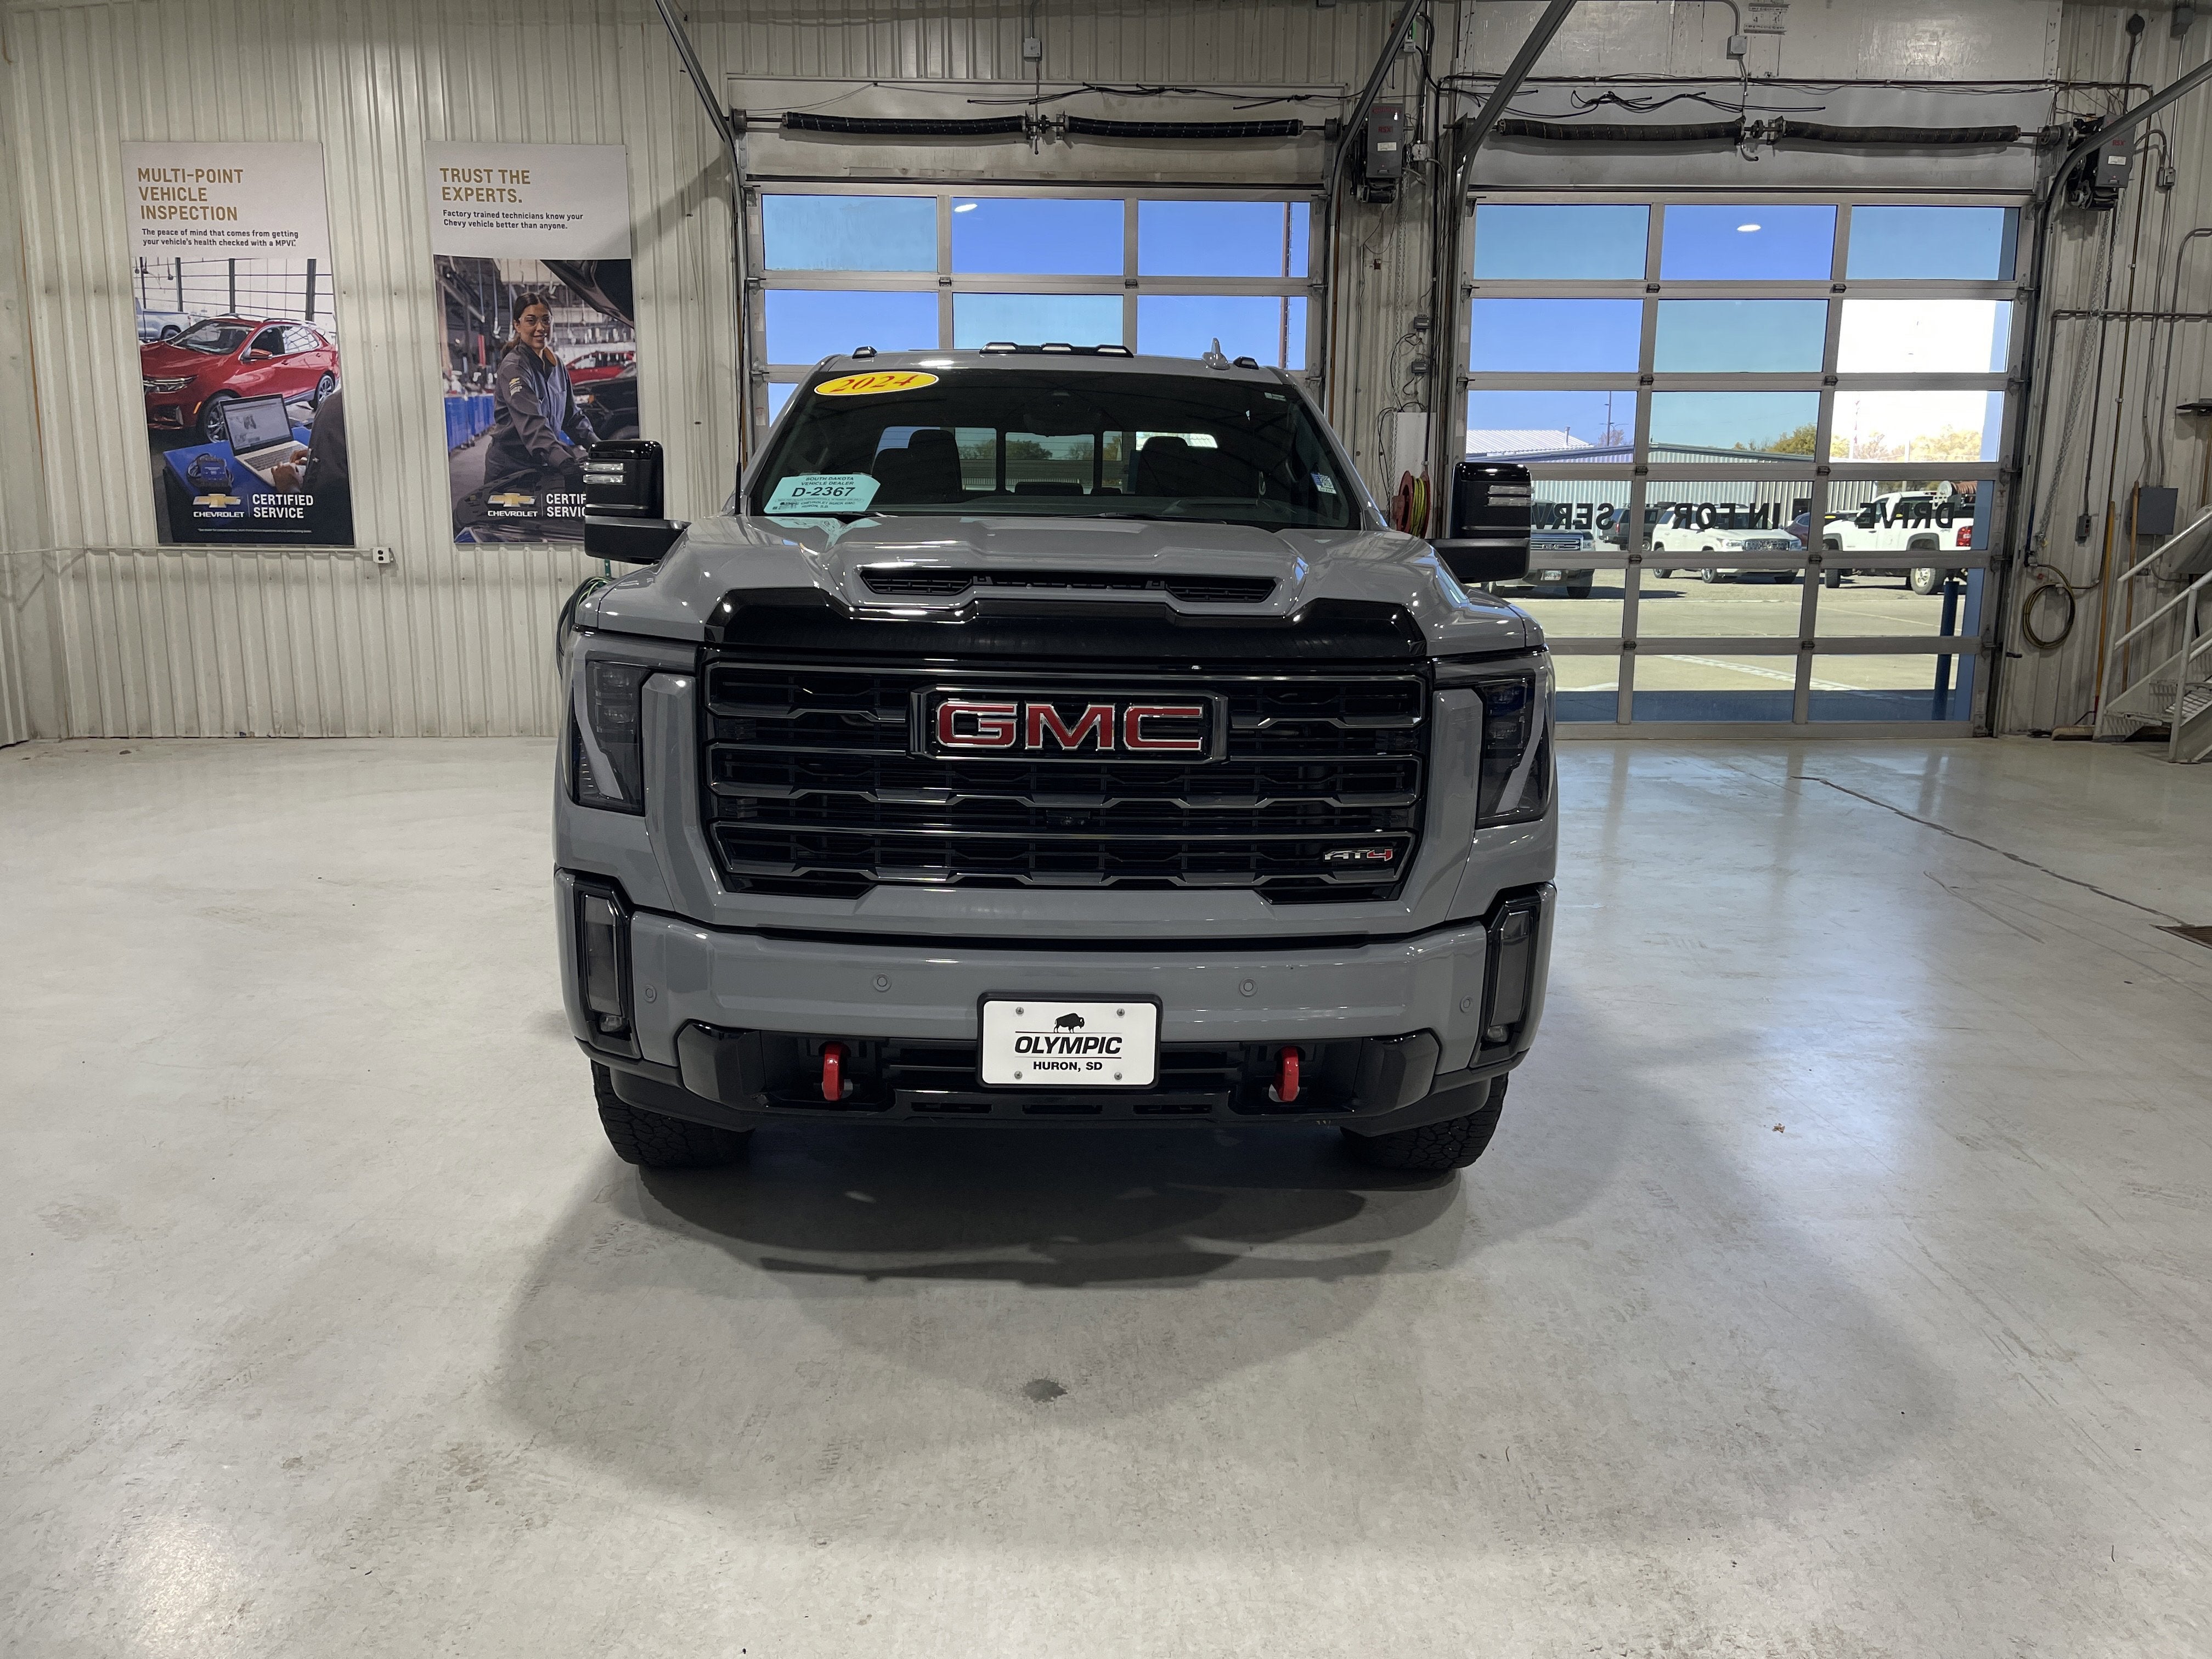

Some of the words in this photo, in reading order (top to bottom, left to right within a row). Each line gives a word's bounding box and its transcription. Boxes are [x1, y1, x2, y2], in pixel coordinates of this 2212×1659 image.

[138, 167, 244, 184] MULTI-POINT
[439, 167, 493, 184] TRUST
[498, 169, 531, 185] THE
[138, 186, 208, 202] VEHICLE
[442, 187, 522, 204] EXPERTS.
[140, 205, 238, 221] INSPECTION
[443, 210, 471, 219] Factory
[444, 219, 466, 228] Chevy
[272, 230, 298, 239] getting
[830, 375, 919, 392] 2024
[792, 487, 856, 497] D-2367
[252, 494, 314, 506] CERTIFIED
[253, 507, 304, 518] SERVICE
[935, 700, 1204, 753] GMC
[1324, 849, 1393, 861] AT4
[1014, 1036, 1122, 1054] OLYMPIC
[1033, 1061, 1081, 1072] HURON,
[1086, 1062, 1103, 1070] SD
